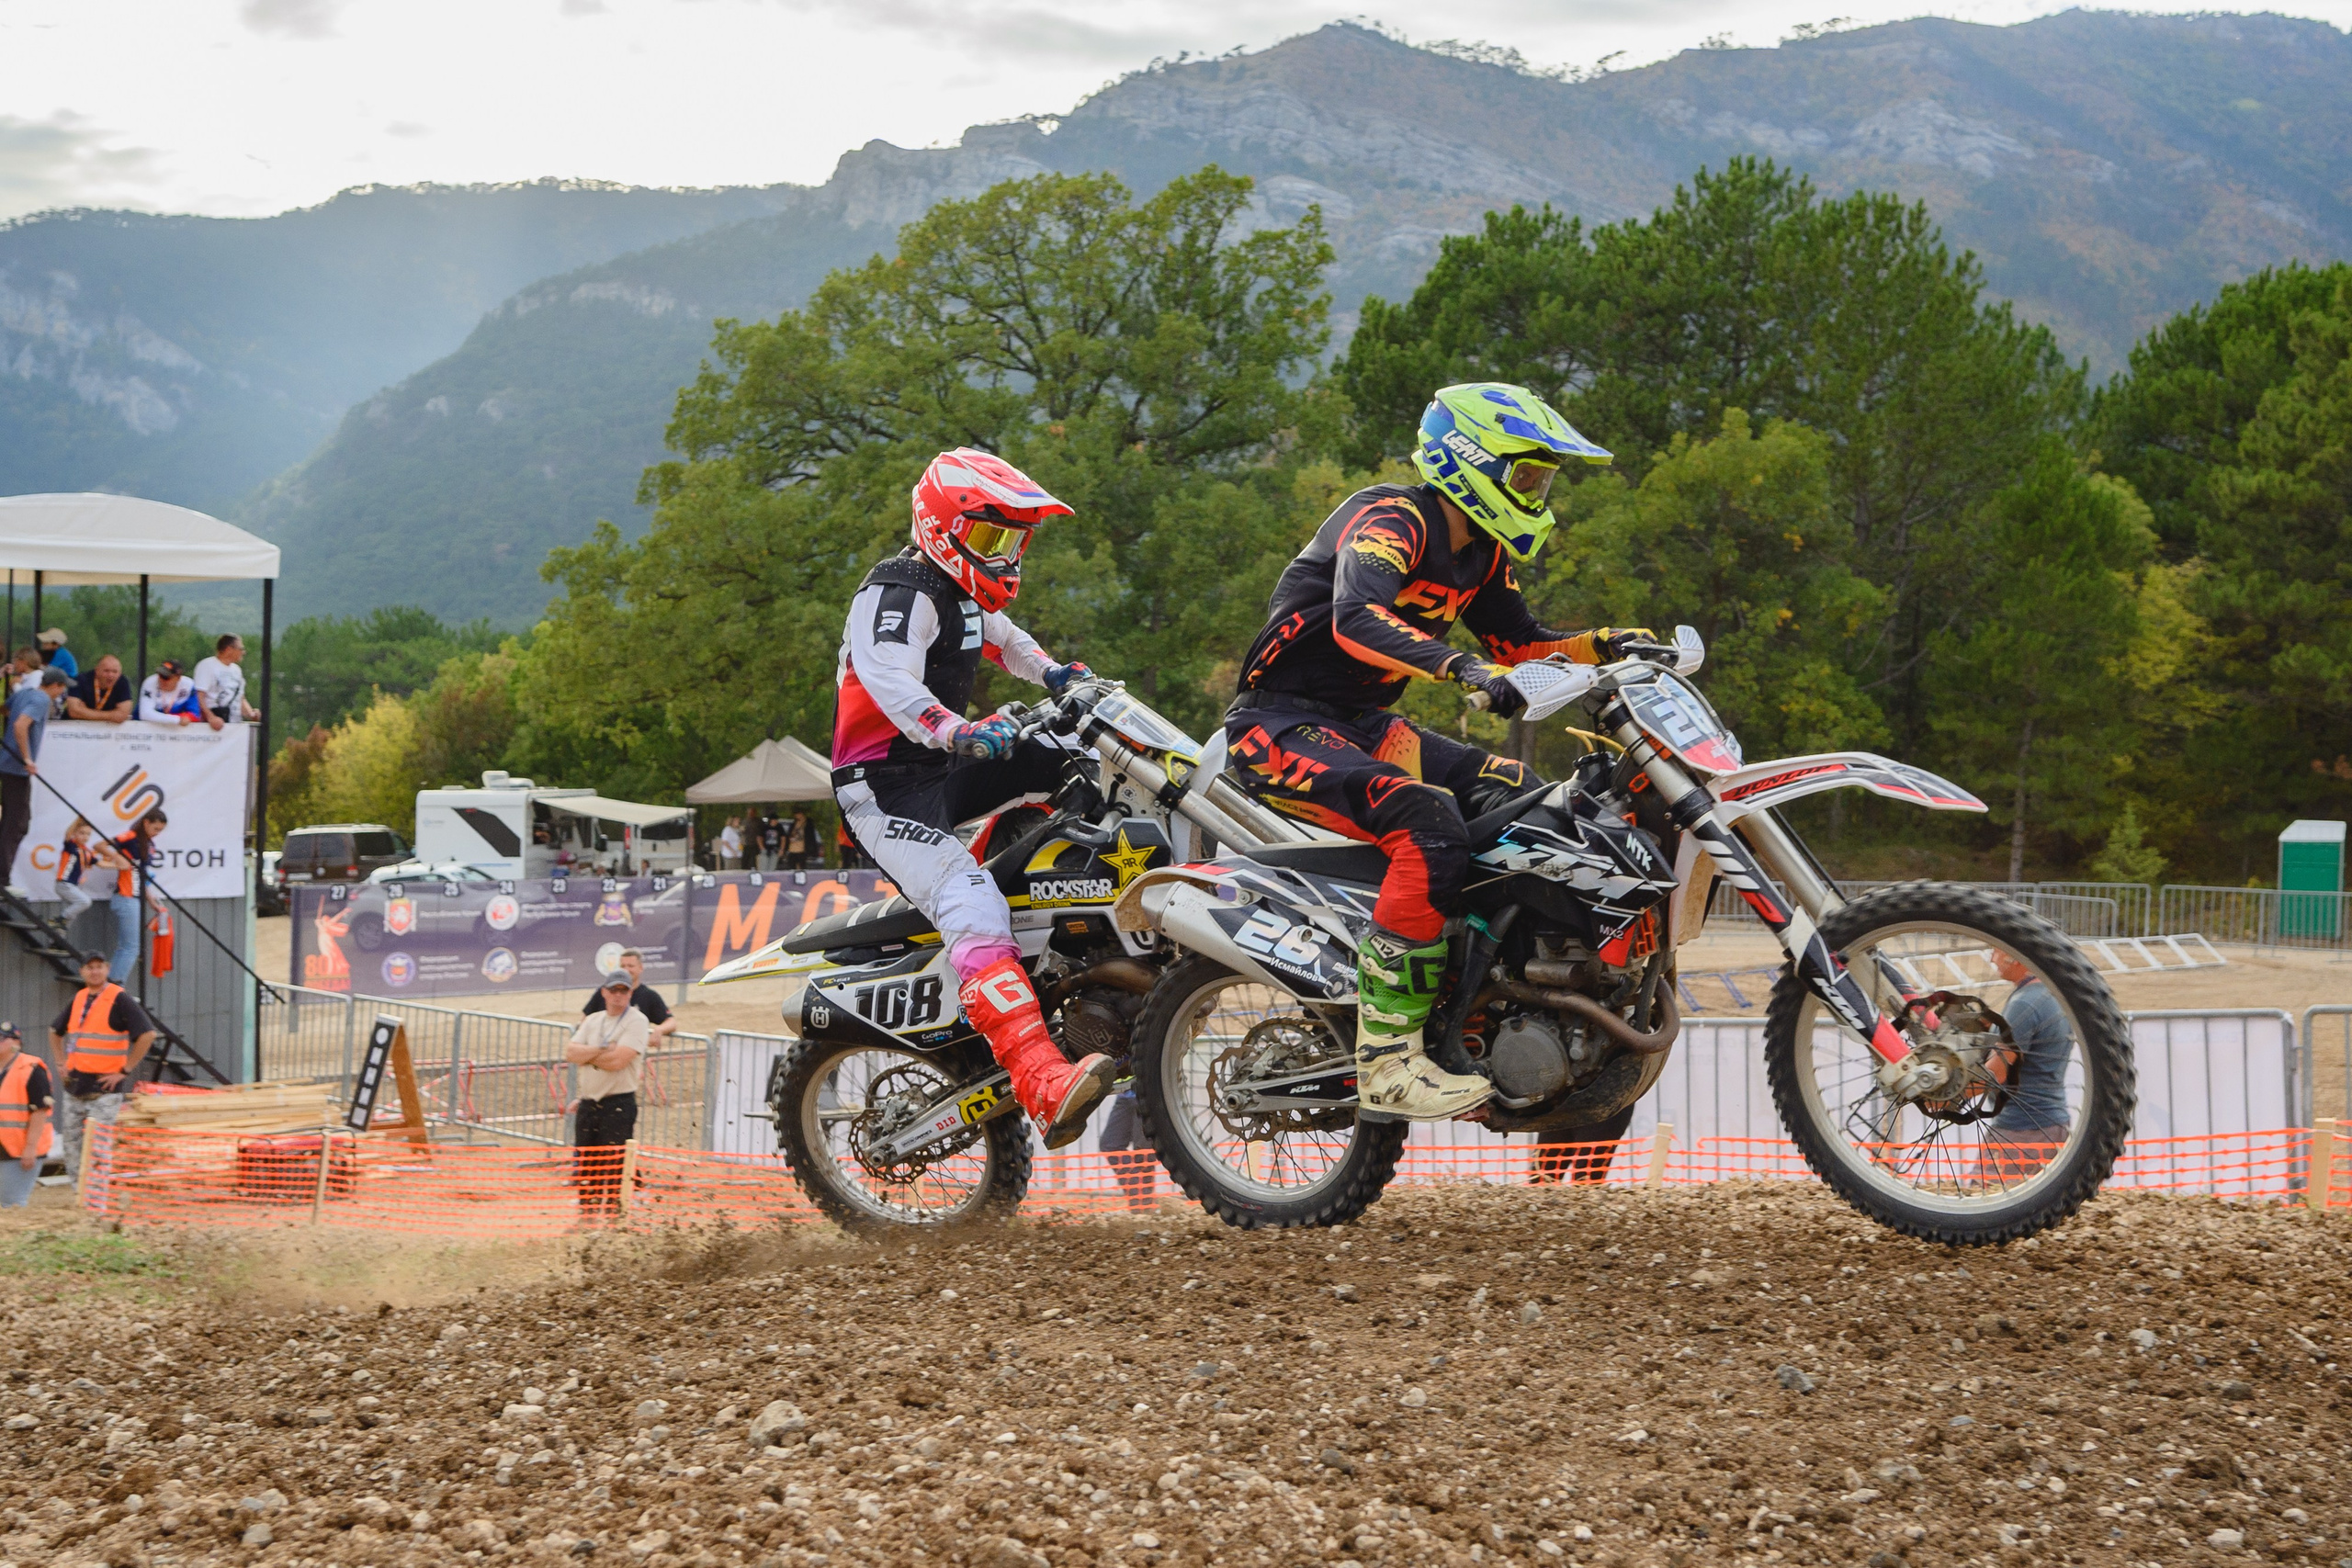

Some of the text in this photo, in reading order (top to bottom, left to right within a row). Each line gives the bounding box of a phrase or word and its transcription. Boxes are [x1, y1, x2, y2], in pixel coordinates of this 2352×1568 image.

[1442, 429, 1497, 466] LEATT
[1394, 580, 1480, 622] FX
[1296, 726, 1345, 749] REVO
[1734, 765, 1831, 796] DUNLOP
[885, 819, 949, 846] SHOT
[1625, 831, 1653, 872] NTK
[332, 885, 346, 899] 27
[499, 881, 514, 894] 24
[603, 878, 616, 891] 22
[1030, 879, 1114, 901] ROCKSTAR
[1233, 908, 1330, 965] 26
[1600, 924, 1624, 940] MX2
[1271, 957, 1319, 982] Исмайлов
[855, 974, 943, 1030] 108
[980, 971, 1035, 1014] G
[922, 1030, 953, 1040] GoPro
[1290, 1085, 1320, 1094] KTM
